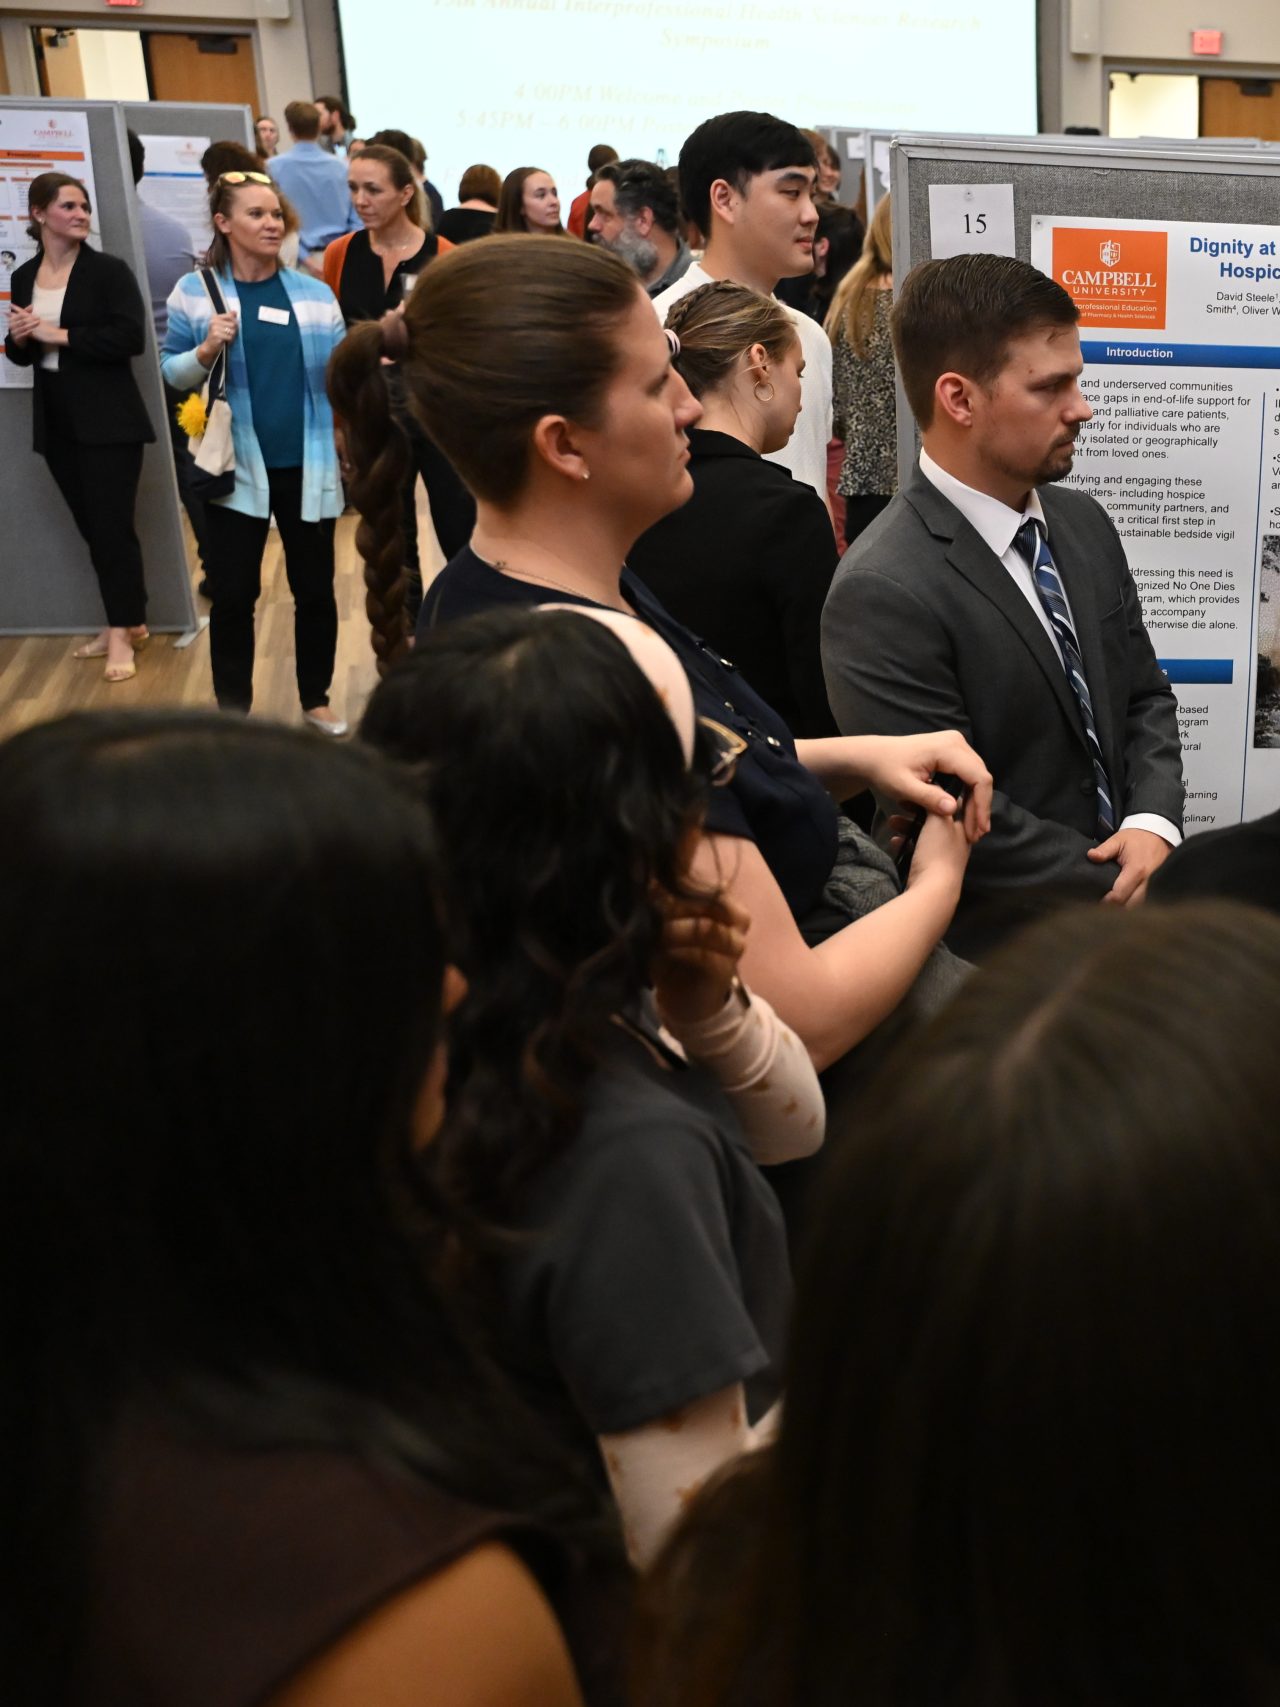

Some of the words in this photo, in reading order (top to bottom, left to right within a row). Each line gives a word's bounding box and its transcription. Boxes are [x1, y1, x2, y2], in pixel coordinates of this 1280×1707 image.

[661, 27, 773, 54] Symposium
[963, 213, 988, 234] 15
[1190, 237, 1254, 259] Dignity
[1259, 241, 1276, 256] at
[1062, 270, 1157, 289] CAMPBELL
[1073, 286, 1147, 296] UNIVERSITY
[1216, 291, 1243, 302] David
[1121, 304, 1158, 312] Education
[1242, 305, 1270, 315] Oliver
[1106, 346, 1173, 358] Introduction
[1103, 379, 1166, 390] underserved
[1169, 382, 1233, 392] communities
[1103, 394, 1128, 405] gaps
[1131, 393, 1140, 403] in
[1143, 394, 1194, 405] end-of-life
[1196, 397, 1235, 407] support
[1237, 396, 1251, 406] for
[1190, 581, 1210, 591] One
[1213, 581, 1235, 591] Dies
[1168, 594, 1196, 604] which
[1198, 595, 1240, 605] provides
[1150, 609, 1206, 619] accompany
